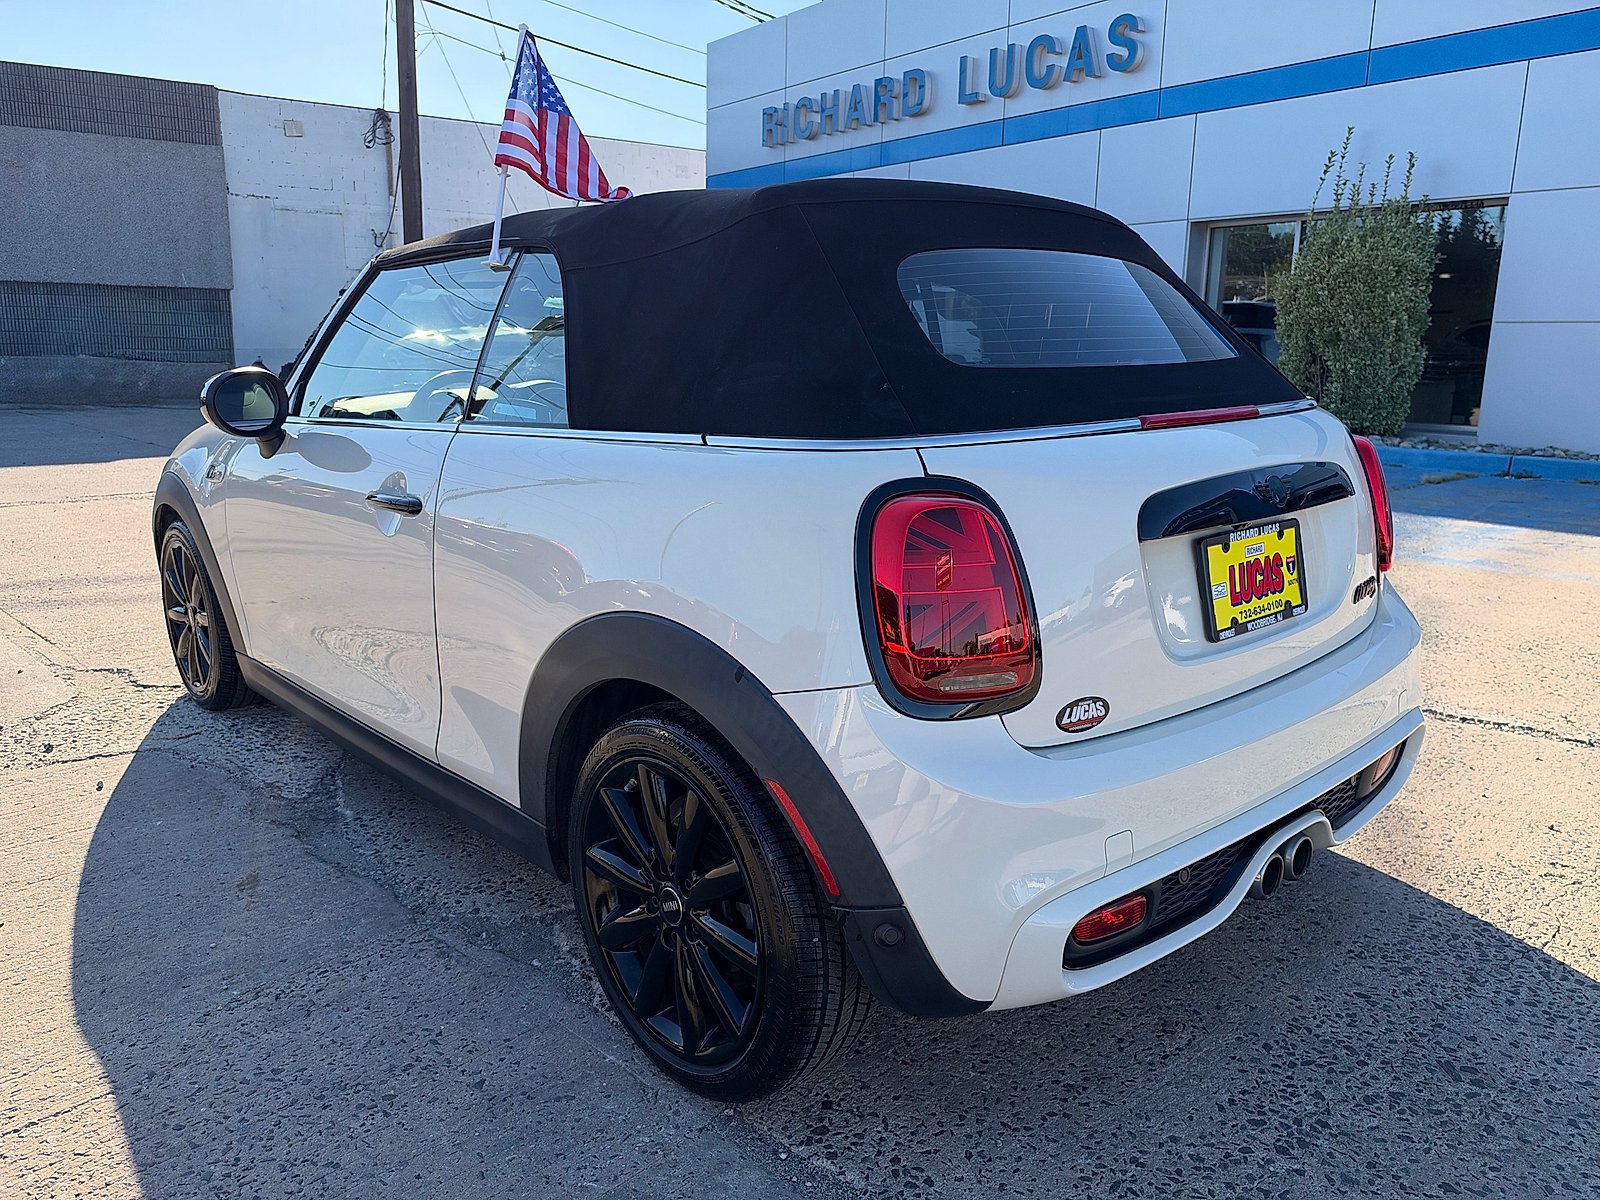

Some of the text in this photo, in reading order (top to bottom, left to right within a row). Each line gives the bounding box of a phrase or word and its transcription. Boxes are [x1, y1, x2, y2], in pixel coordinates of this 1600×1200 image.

[762, 12, 1147, 148] RICHARD LUCAS
[1229, 523, 1280, 542] RICHARD LUCAS
[1246, 545, 1263, 555] RICHARD
[1229, 552, 1284, 606] LUCAS
[1239, 599, 1283, 620] 732-634-0100
[1061, 701, 1106, 724] LUCAS
[662, 900, 679, 912] MINI
